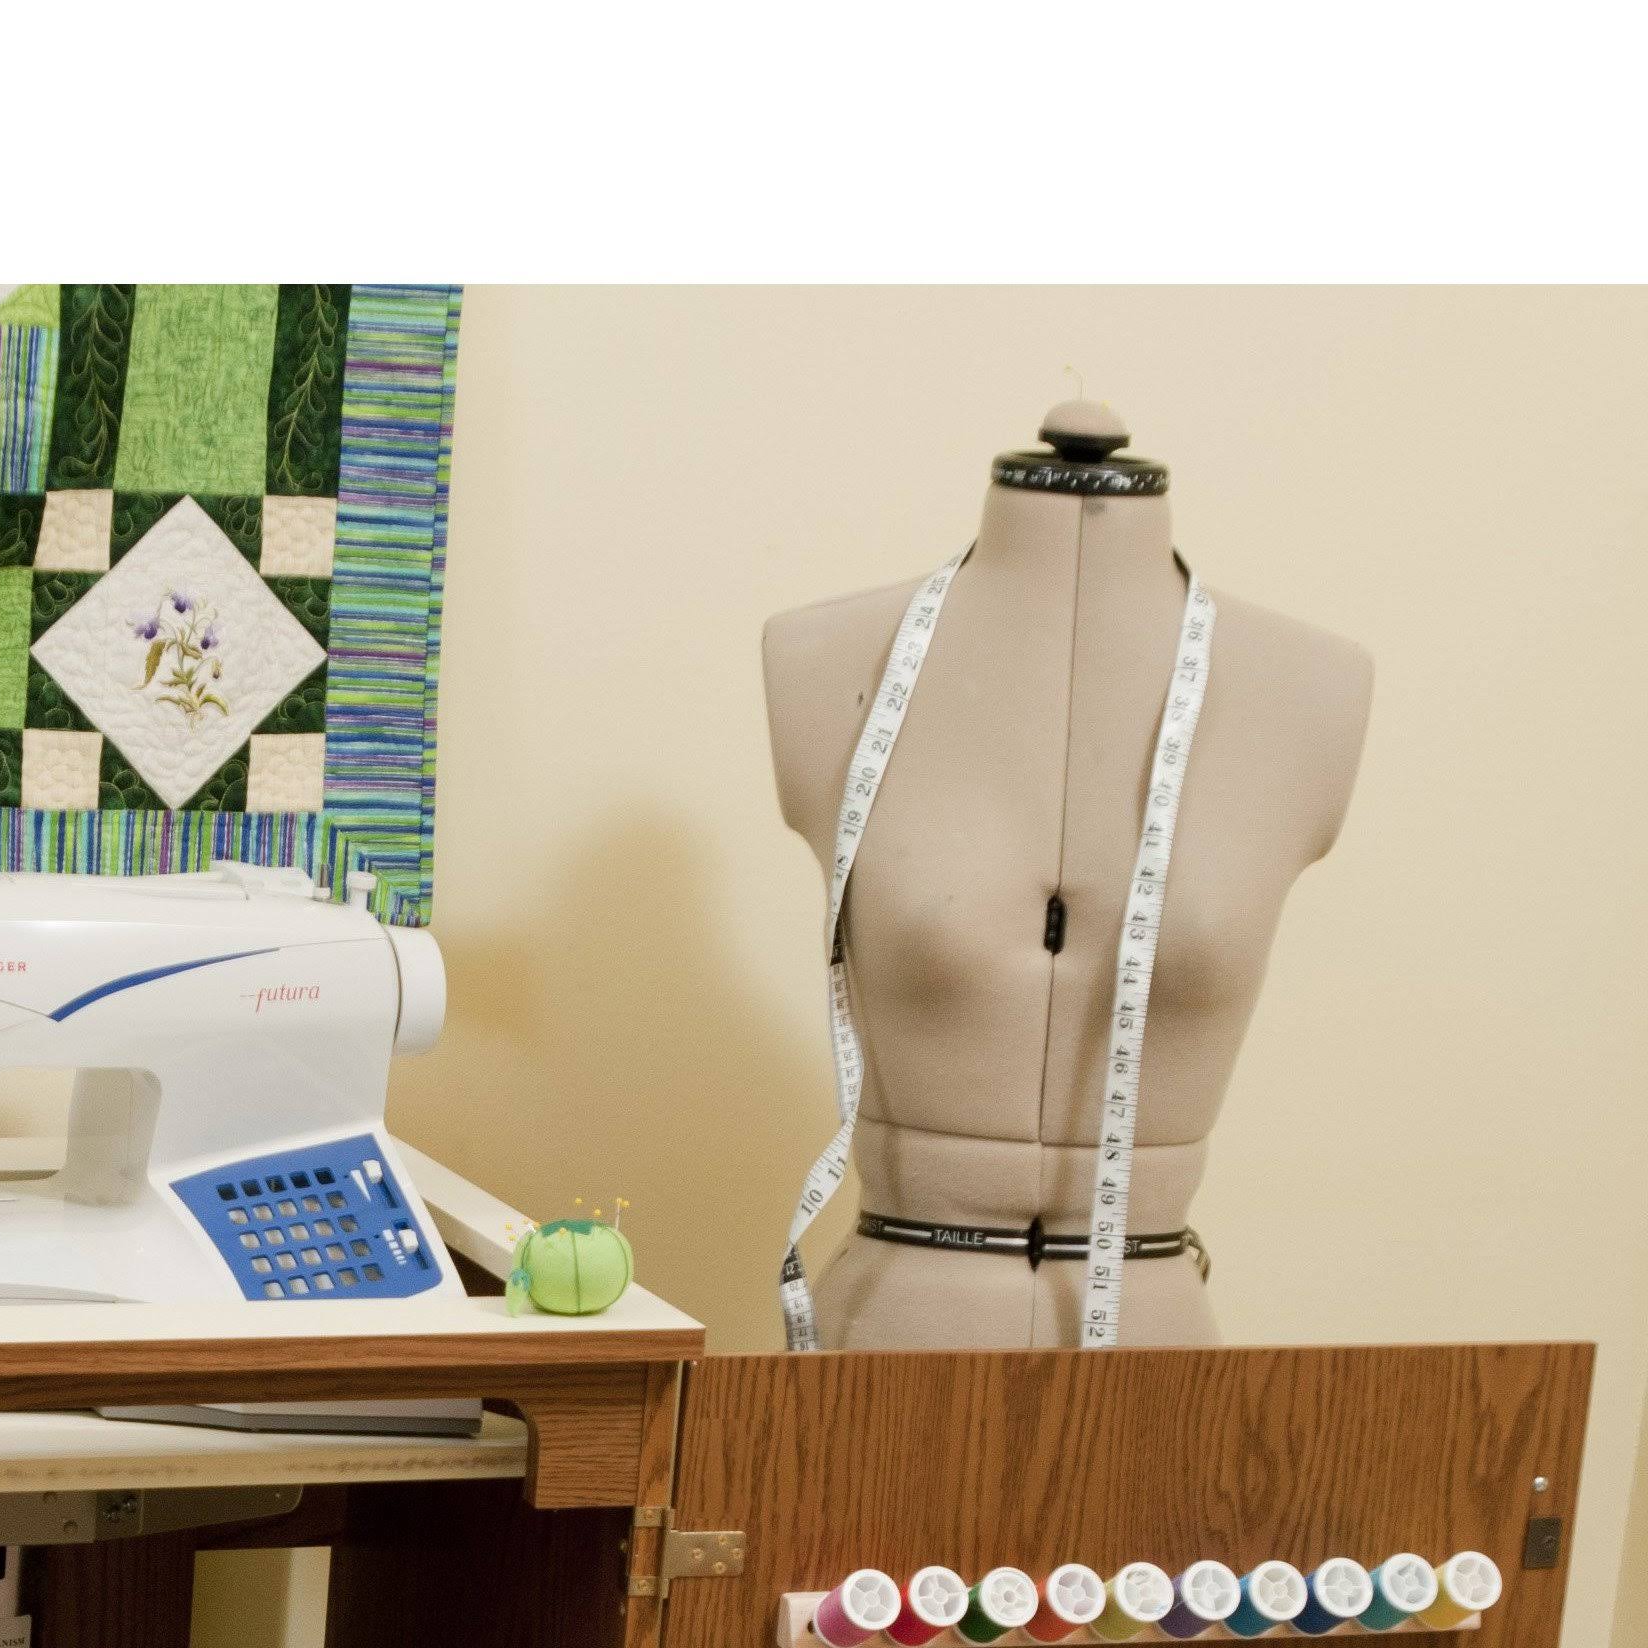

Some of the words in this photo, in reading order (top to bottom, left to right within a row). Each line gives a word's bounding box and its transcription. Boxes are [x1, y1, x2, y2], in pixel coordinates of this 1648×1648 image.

[915, 605, 935, 629] 24
[1187, 616, 1205, 642] 36
[903, 640, 923, 670] 23
[1180, 656, 1199, 682] 37
[887, 682, 908, 711] 22
[872, 728, 894, 754] 21
[1163, 736, 1181, 765] 39
[856, 766, 877, 797] 20
[1154, 779, 1173, 807] 40
[844, 809, 862, 838] 19
[1145, 821, 1163, 848] 41
[1137, 866, 1155, 896] 42
[1129, 910, 1148, 941] 43
[1123, 955, 1141, 985] 44
[254, 984, 321, 1013] futura
[1118, 1000, 1136, 1031] 45
[1113, 1044, 1131, 1075] 46
[1110, 1089, 1126, 1119] 47
[1104, 1131, 1122, 1161] 48
[827, 1156, 847, 1181] 11
[801, 1188, 824, 1216] 10
[1100, 1176, 1117, 1206] 49
[934, 1229, 985, 1246] TAILLE
[1096, 1220, 1114, 1250] 50
[1093, 1265, 1110, 1290] 51
[1089, 1309, 1107, 1338] 52
